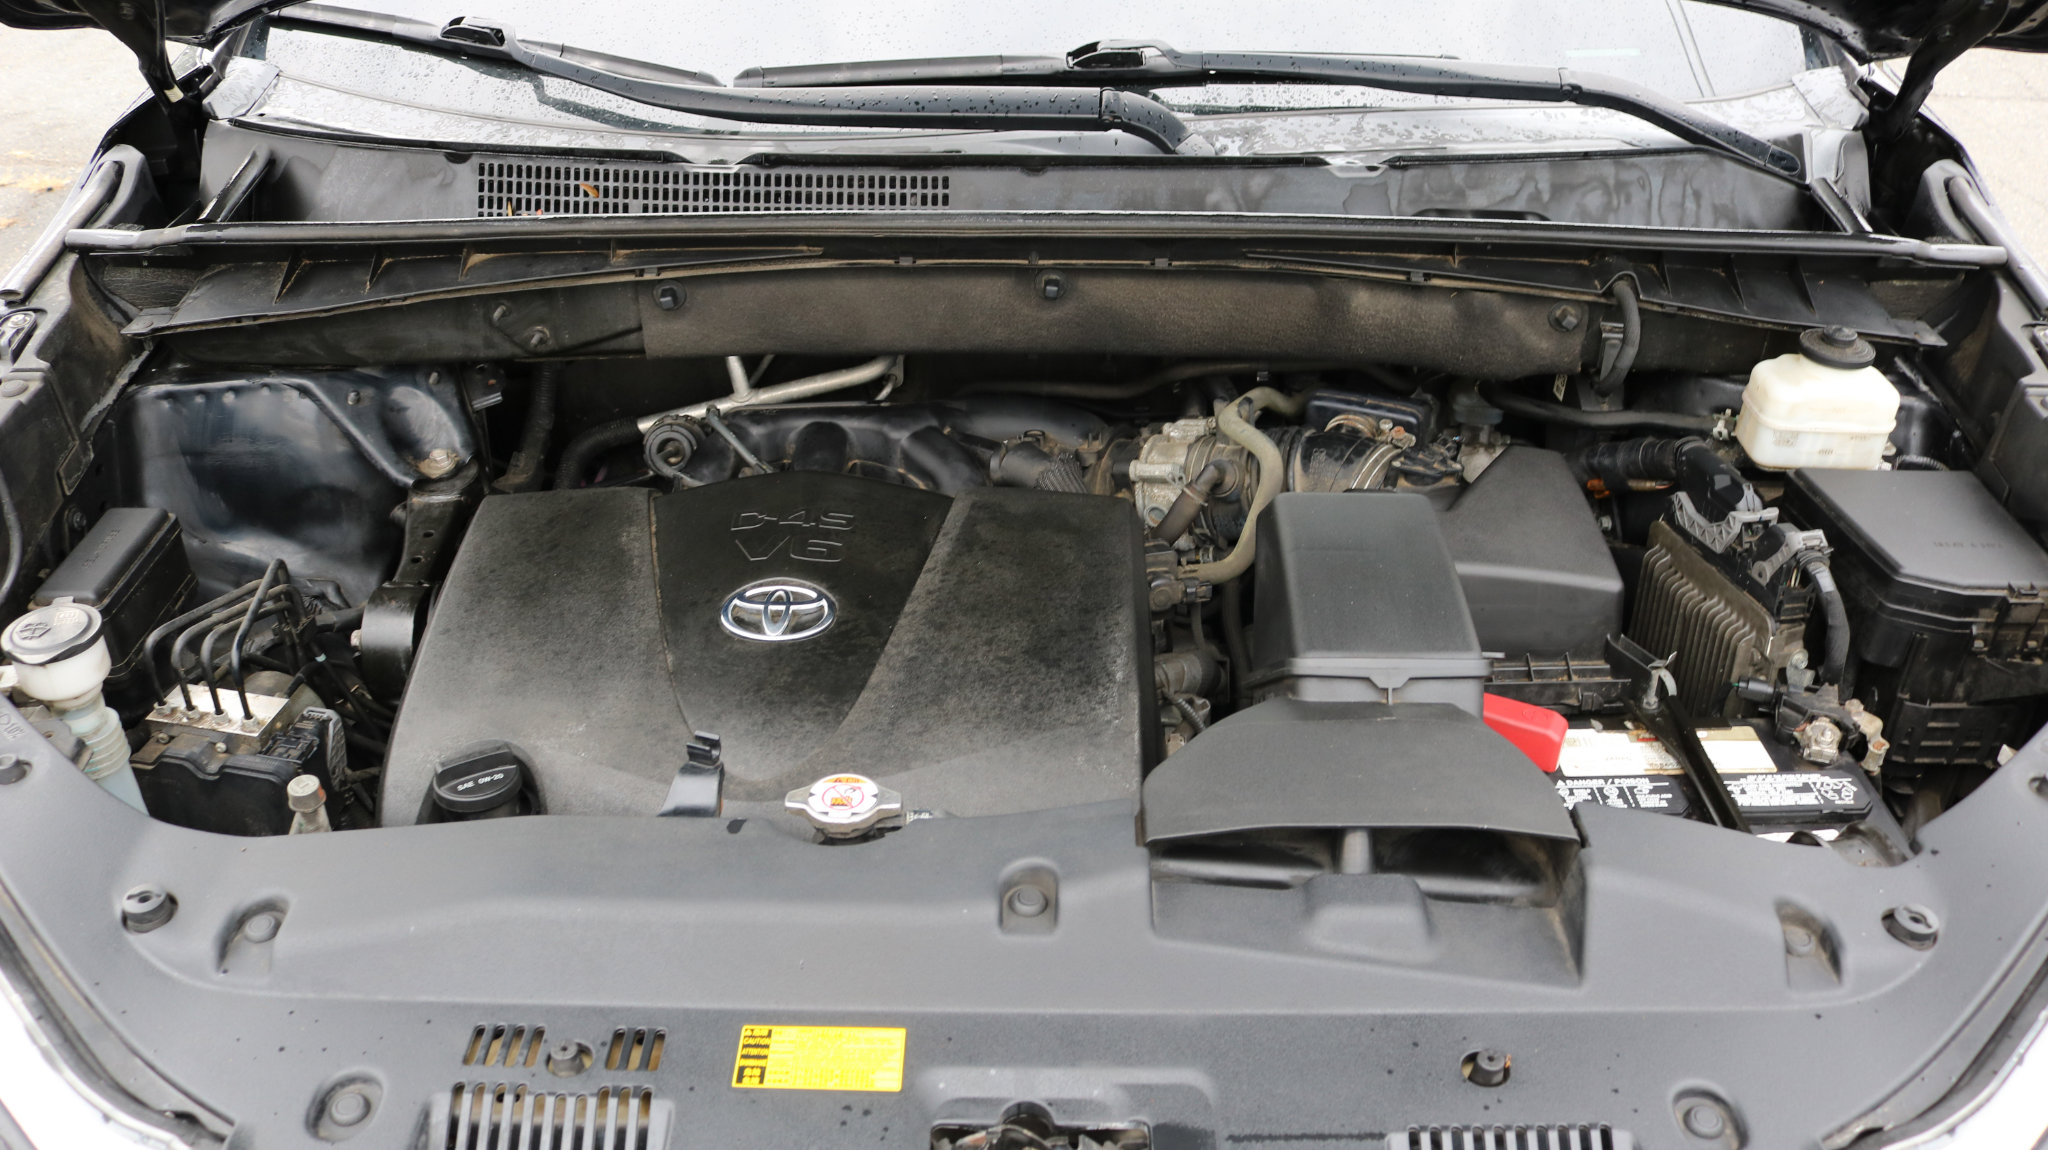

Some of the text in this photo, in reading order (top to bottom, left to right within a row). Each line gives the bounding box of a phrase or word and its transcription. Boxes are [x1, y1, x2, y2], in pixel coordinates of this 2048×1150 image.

[731, 510, 854, 531] D-4S
[735, 535, 844, 562] V6
[456, 781, 475, 791] SAE
[1614, 778, 1650, 786] POISON
[743, 1037, 771, 1046] CAUTION
